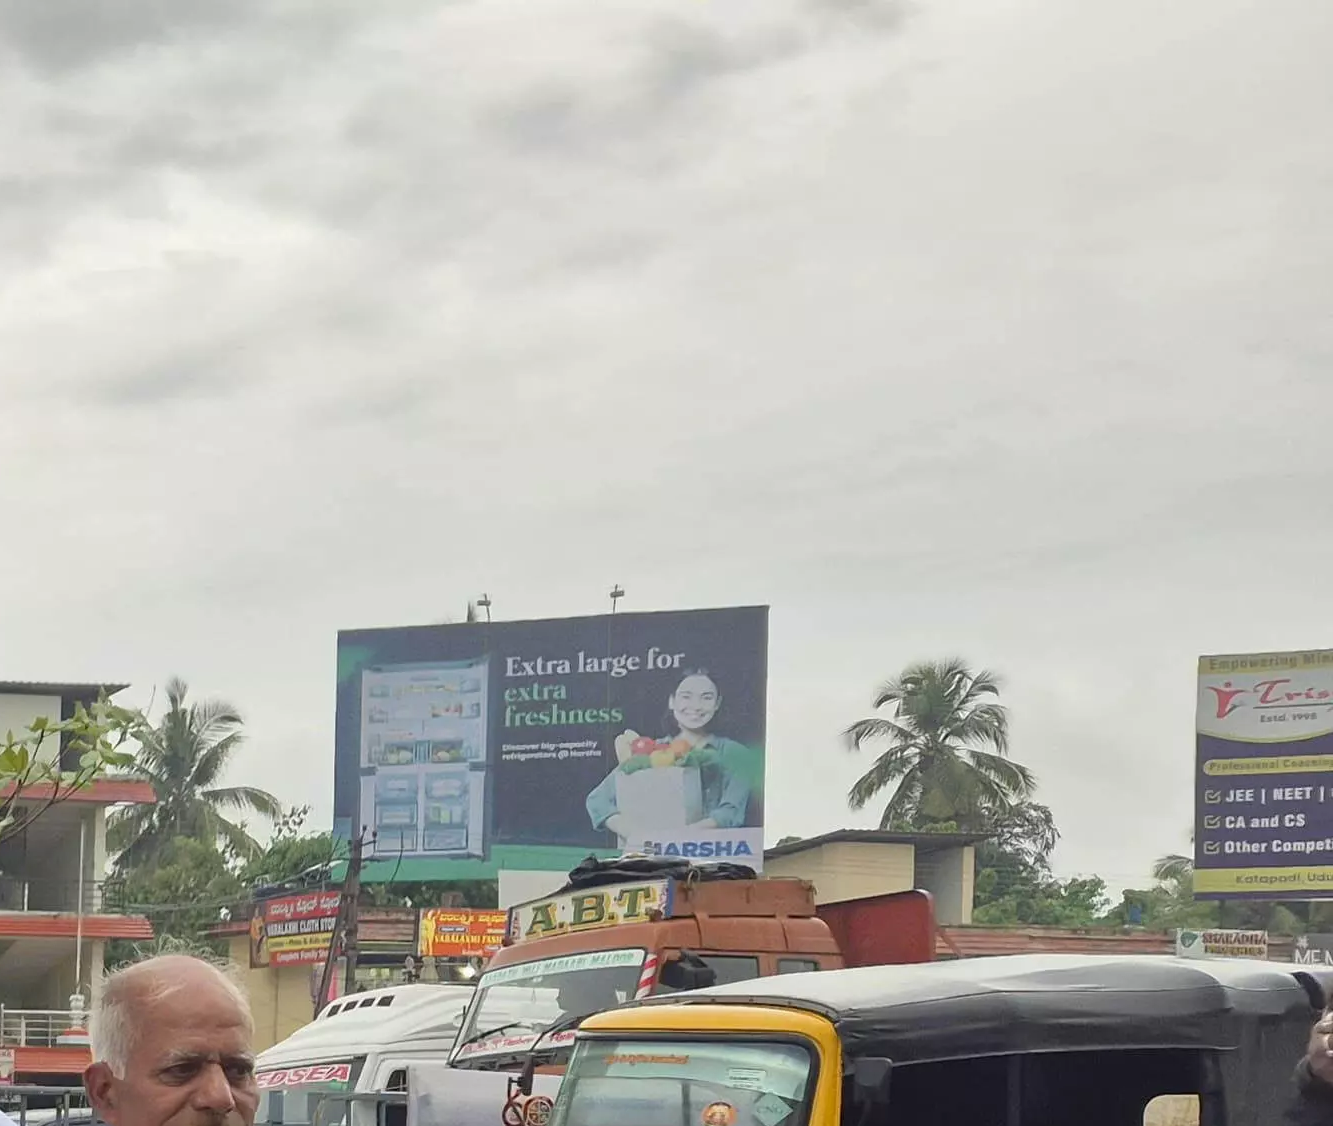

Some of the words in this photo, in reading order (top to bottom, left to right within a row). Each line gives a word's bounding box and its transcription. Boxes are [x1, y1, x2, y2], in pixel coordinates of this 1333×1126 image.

[505, 656, 571, 677] Extra
[578, 651, 640, 678] large
[647, 647, 685, 670] for
[1303, 652, 1333, 664] Min
[504, 682, 567, 702] extra
[1253, 679, 1333, 704] Tris
[504, 704, 624, 727] freshness
[1209, 760, 1278, 771] Professional
[1225, 789, 1254, 802] JEE
[1273, 787, 1313, 801] NEET
[1225, 816, 1246, 829] CA
[1251, 815, 1279, 828] and
[1284, 814, 1306, 828] CS
[1224, 840, 1268, 854] Other
